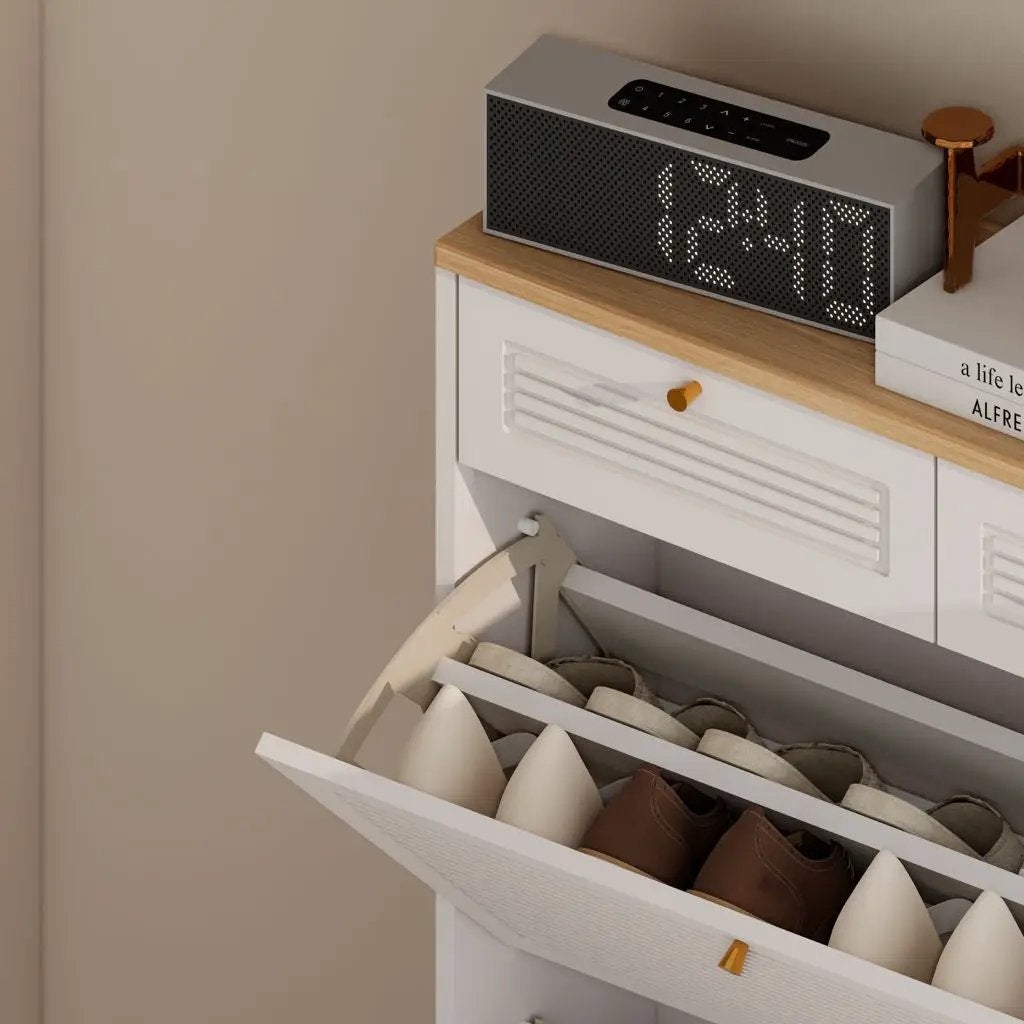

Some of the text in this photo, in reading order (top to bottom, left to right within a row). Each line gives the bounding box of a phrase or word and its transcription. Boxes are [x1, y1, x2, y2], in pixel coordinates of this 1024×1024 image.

[657, 159, 874, 327] 12:40
[961, 362, 971, 376] a
[976, 362, 1004, 390] life
